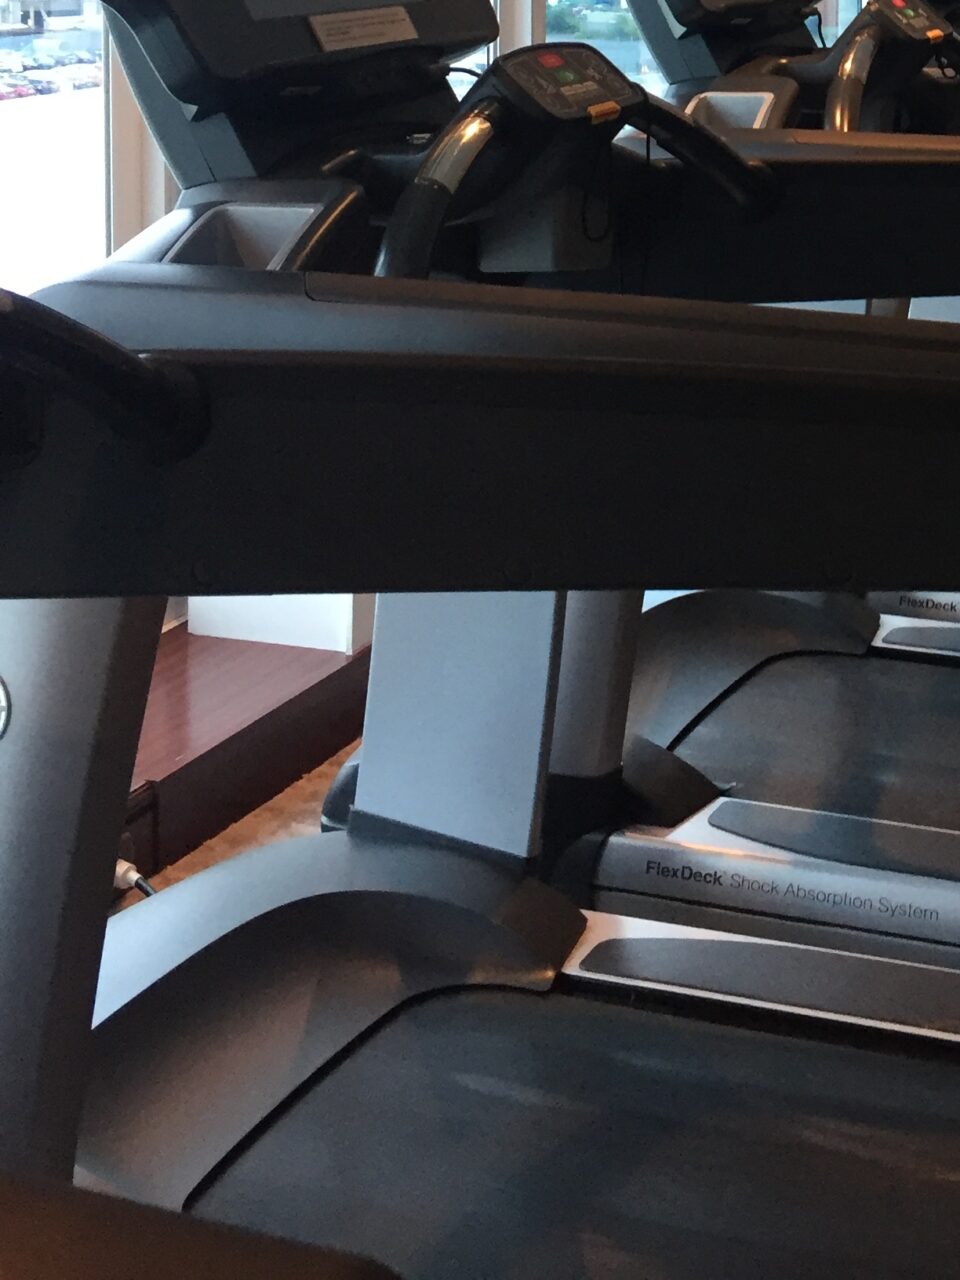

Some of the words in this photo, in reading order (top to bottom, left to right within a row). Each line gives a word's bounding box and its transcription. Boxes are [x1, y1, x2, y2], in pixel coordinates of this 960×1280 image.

[899, 596, 957, 612] FlexDeck
[645, 860, 723, 886] FlexDeck
[730, 873, 780, 896] Shock
[783, 883, 873, 911] Absorption
[878, 897, 939, 921] System
